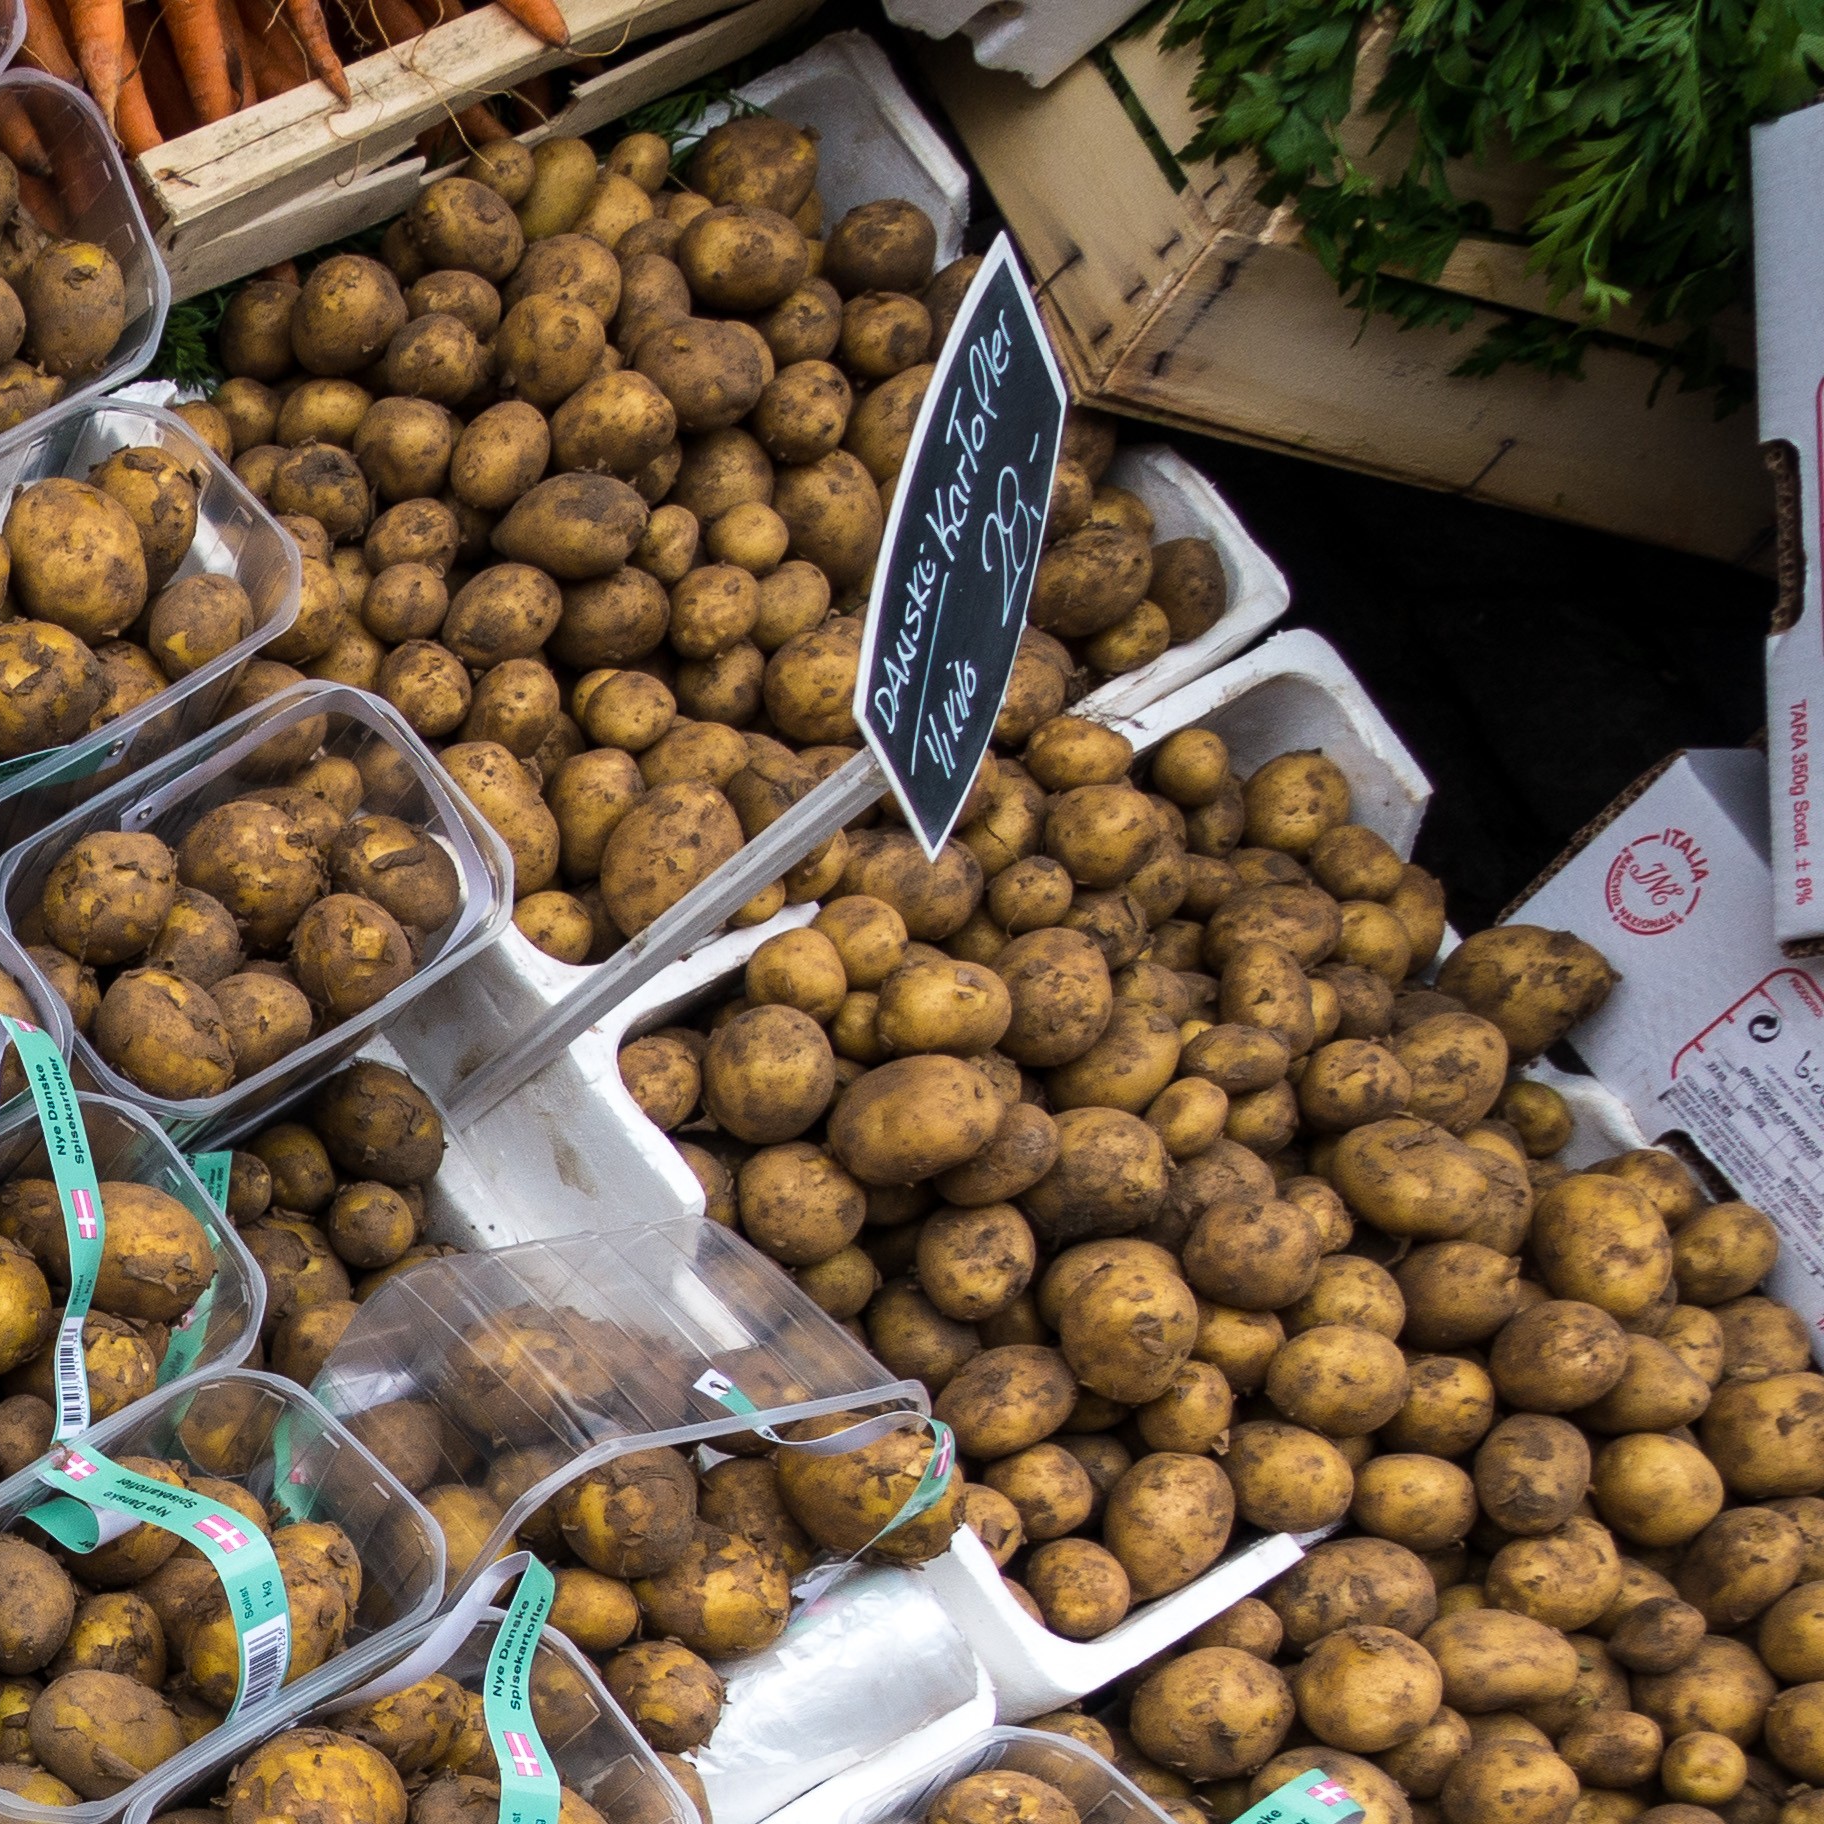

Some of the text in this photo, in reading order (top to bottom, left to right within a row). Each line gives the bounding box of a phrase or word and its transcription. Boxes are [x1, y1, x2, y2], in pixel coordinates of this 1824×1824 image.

[1790, 699, 1808, 750] TARA
[1662, 827, 1709, 883] ITALIA
[36, 1064, 66, 1156] Nye Danske
[49, 1057, 85, 1164] Spisekartofler
[102, 1490, 172, 1518] Nye Danske
[116, 1477, 198, 1510] Spisekartofler
[239, 1586, 254, 1619] Solist
[262, 1580, 273, 1598] kg
[492, 1599, 530, 1698] Nye Danske
[510, 1595, 547, 1712] Spisekartofler
